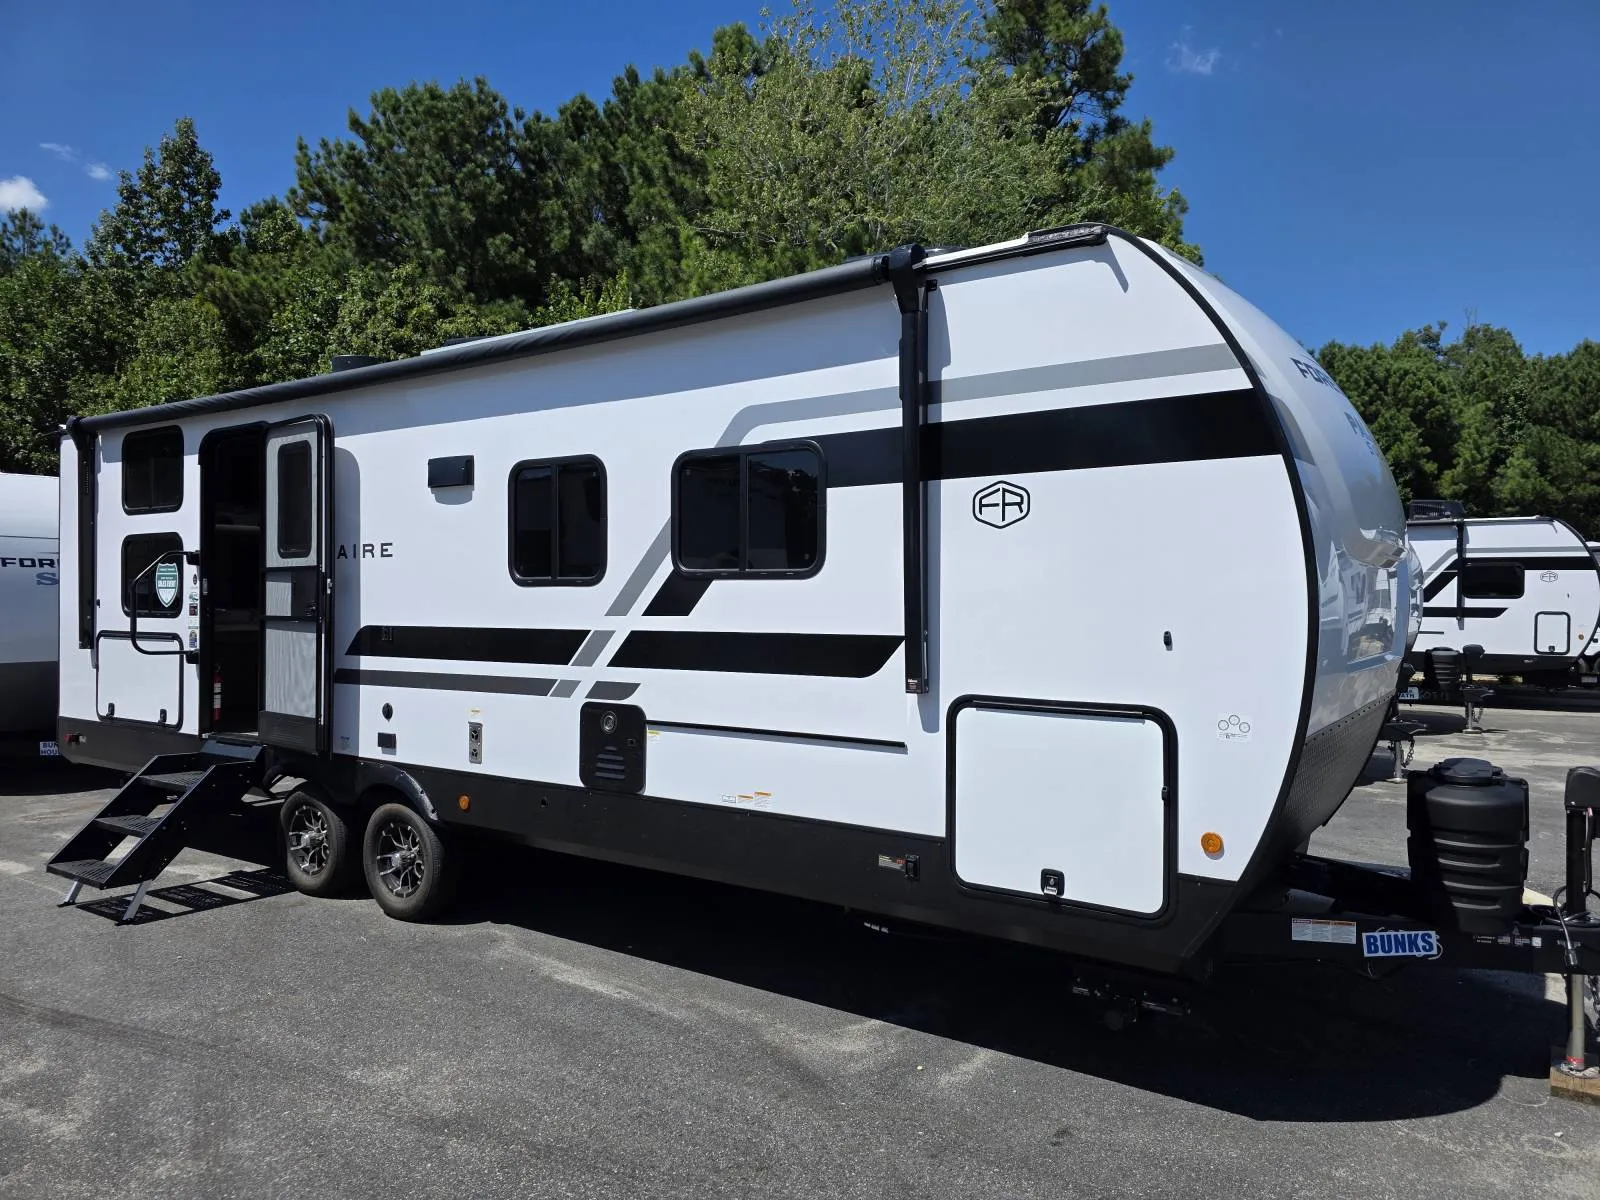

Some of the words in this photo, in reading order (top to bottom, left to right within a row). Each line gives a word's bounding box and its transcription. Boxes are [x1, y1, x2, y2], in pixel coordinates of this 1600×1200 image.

[978, 486, 1024, 522] FR
[336, 542, 393, 560] AIRE
[0, 557, 59, 568] FOR
[1365, 932, 1434, 954] BUNKS
